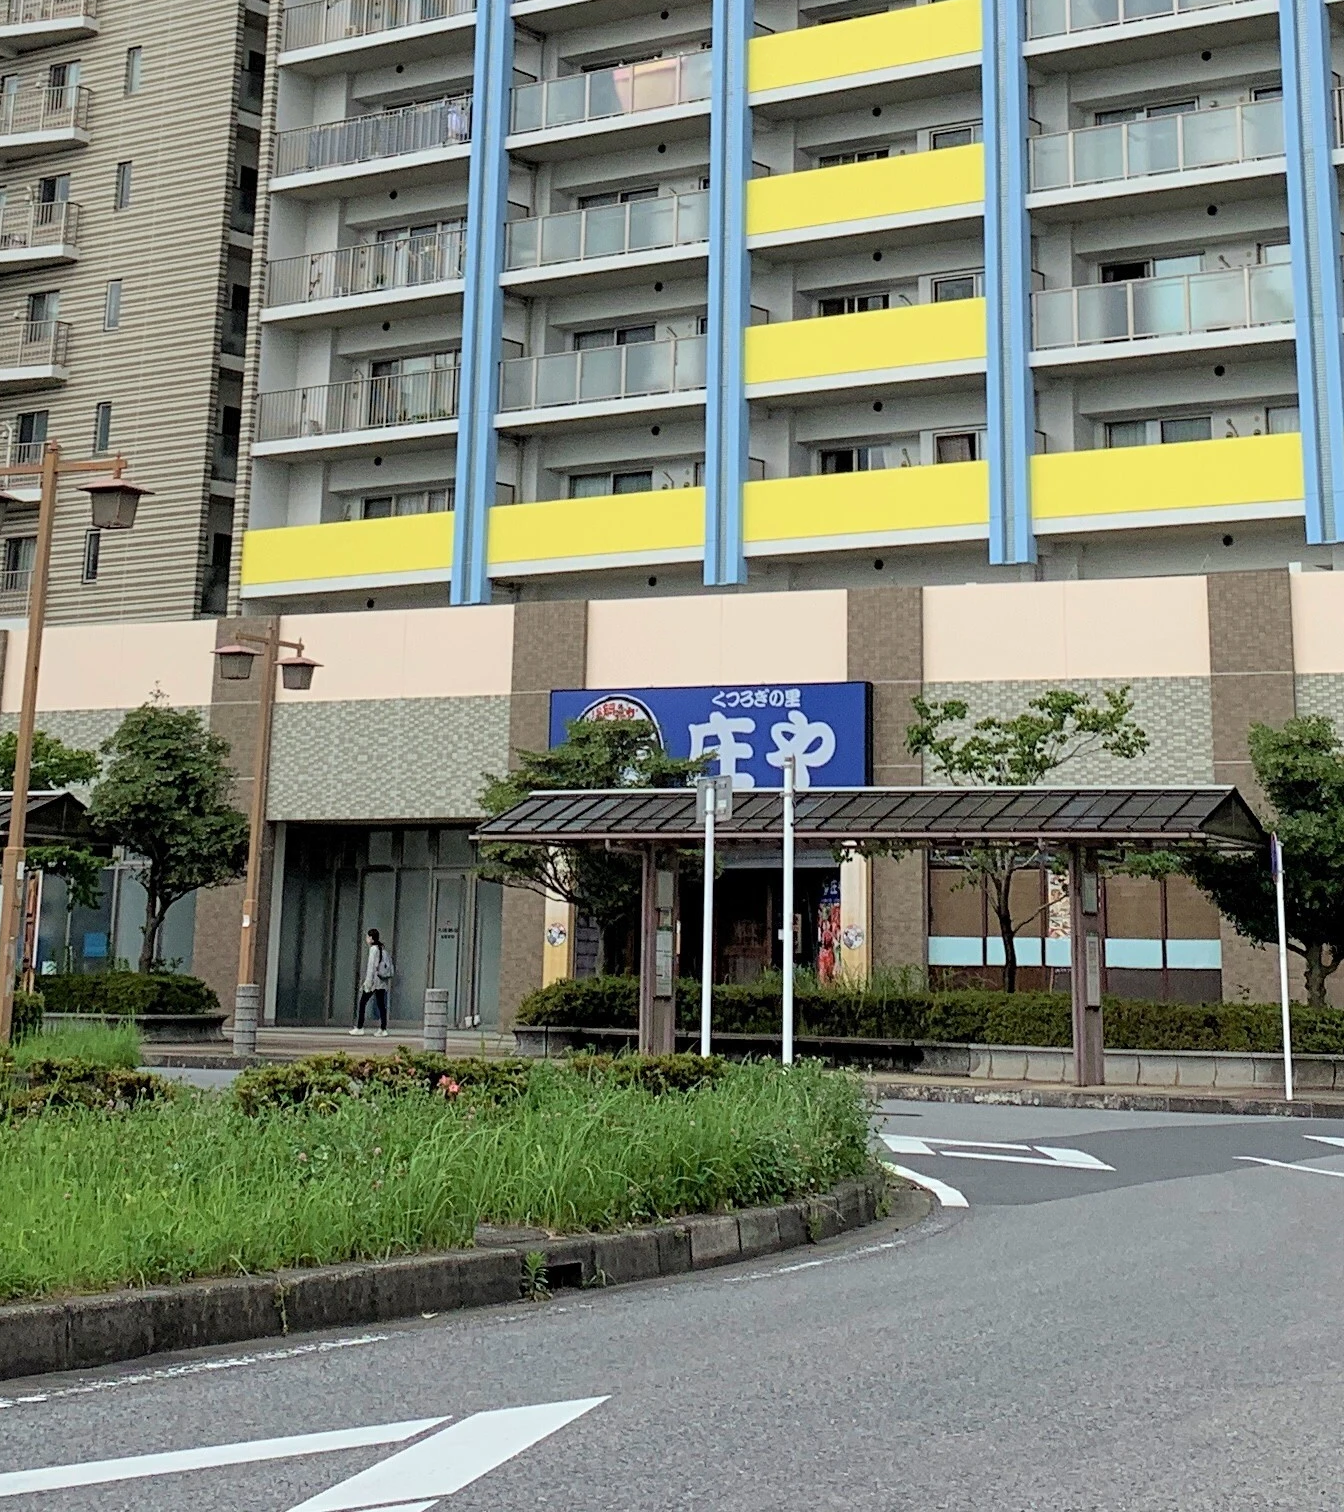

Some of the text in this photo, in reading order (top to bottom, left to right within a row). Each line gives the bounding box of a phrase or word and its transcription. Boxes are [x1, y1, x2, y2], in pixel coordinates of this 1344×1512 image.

[712, 688, 801, 708] くつろぎの里
[688, 710, 836, 788] 庄や
